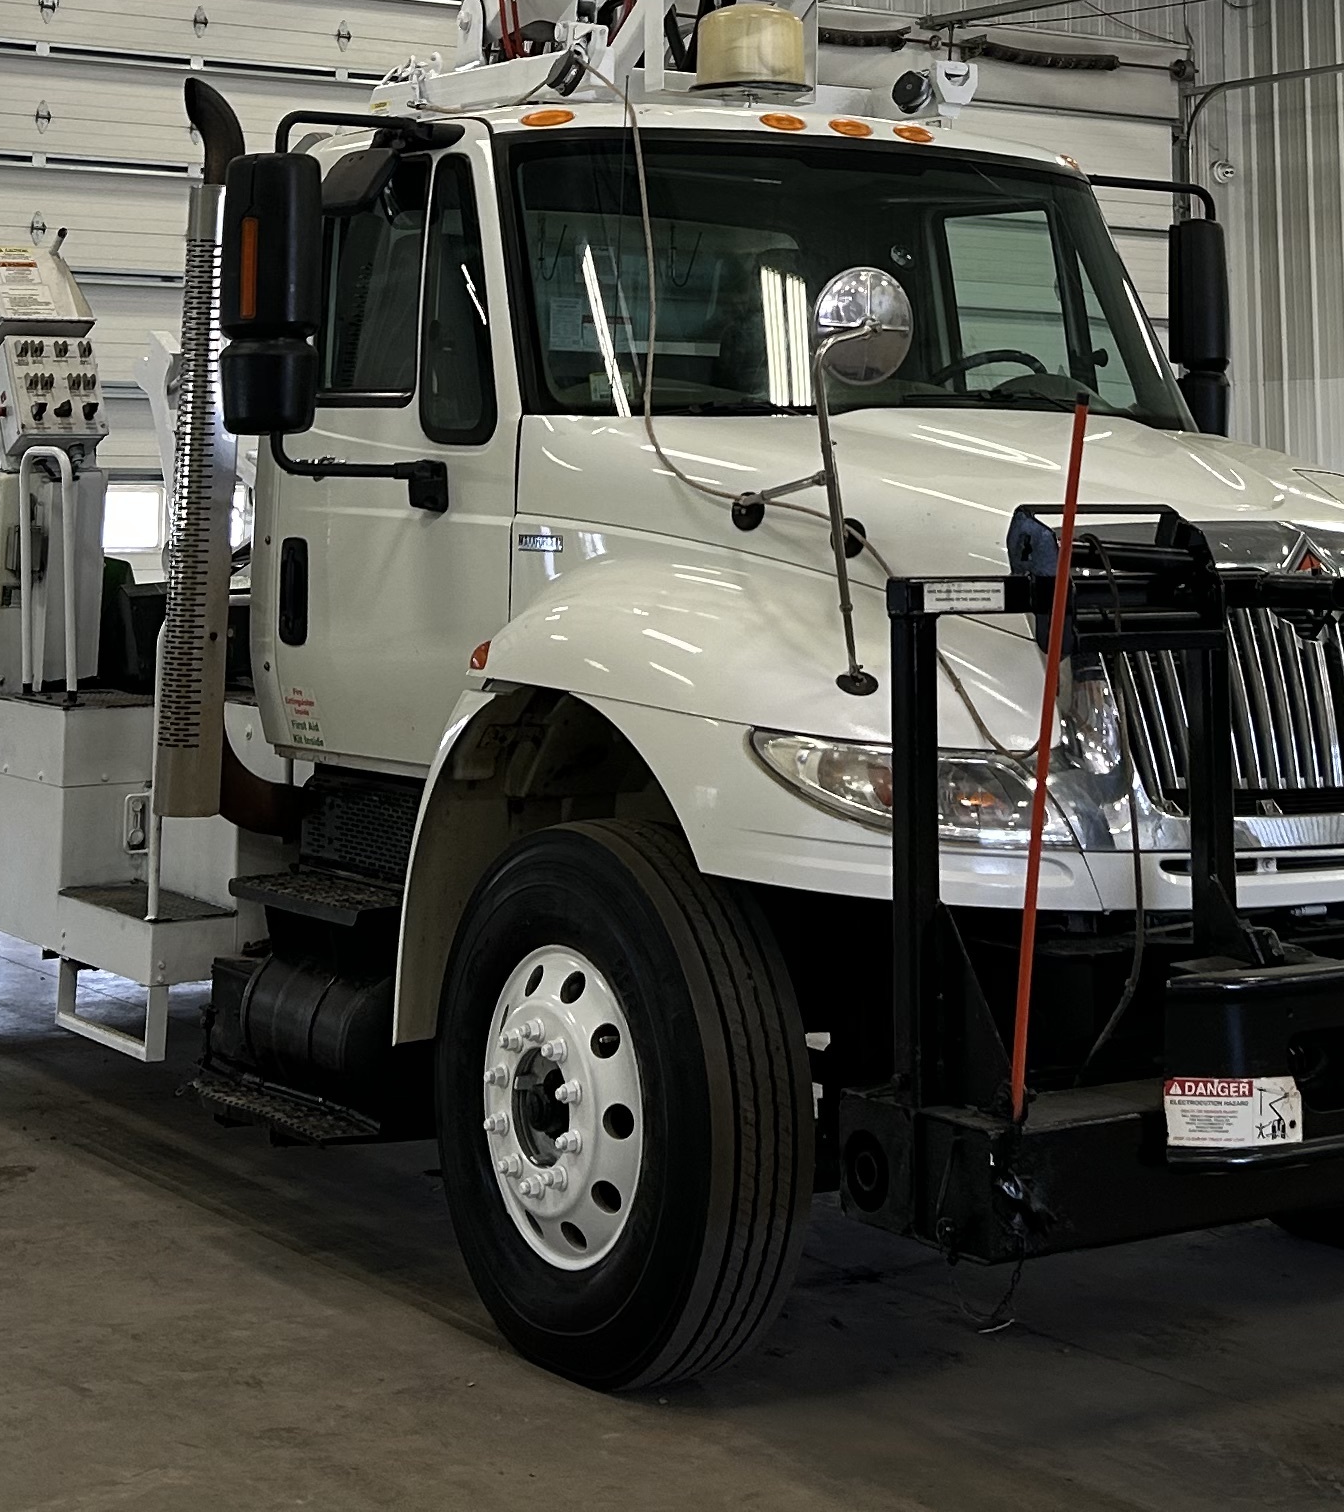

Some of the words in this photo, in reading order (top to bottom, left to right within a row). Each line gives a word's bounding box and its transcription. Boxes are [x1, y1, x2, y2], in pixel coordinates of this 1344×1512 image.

[291, 719, 307, 731] First
[308, 721, 320, 732] Aid
[292, 734, 303, 744] Kit
[304, 735, 324, 747] Inside
[1184, 1081, 1249, 1096] DANGER
